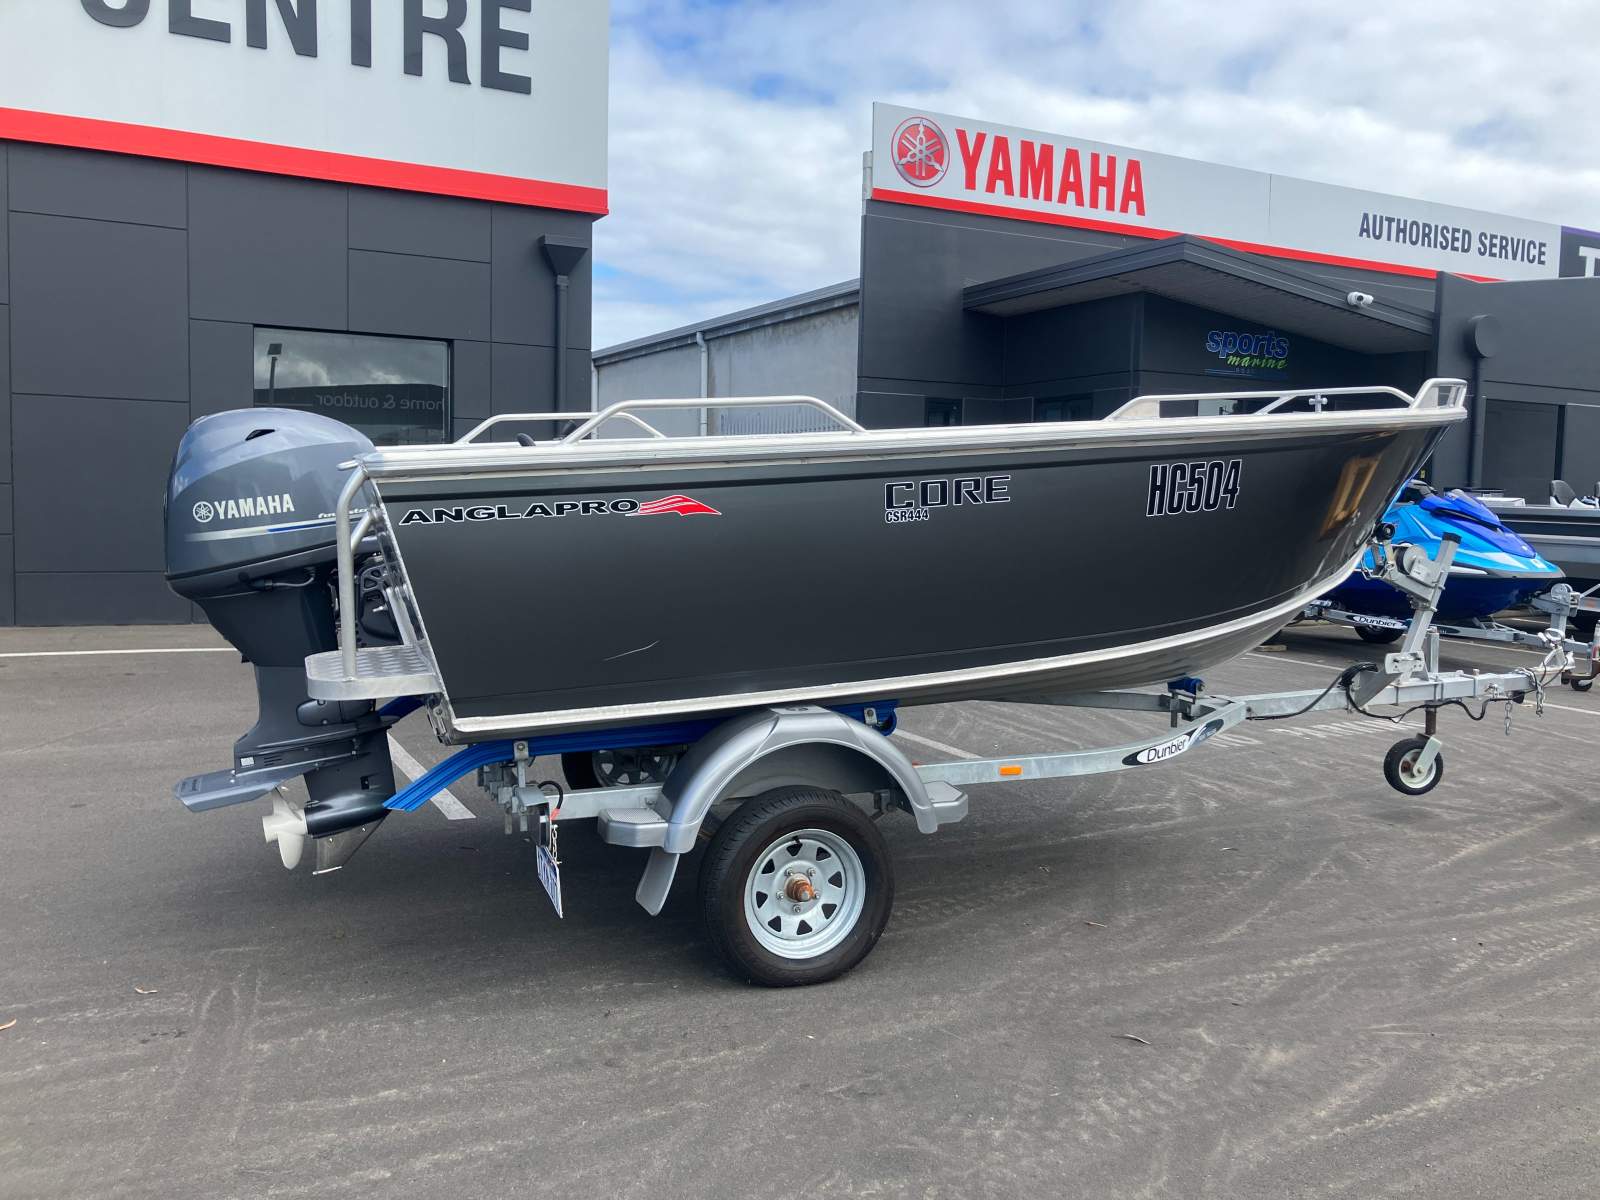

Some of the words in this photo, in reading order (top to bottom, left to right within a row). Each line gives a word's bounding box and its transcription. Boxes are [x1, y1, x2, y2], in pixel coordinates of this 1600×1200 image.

[955, 128, 1146, 217] YAMAHA
[1358, 212, 1472, 254] AUTHORISED
[1477, 231, 1547, 266] SERVICE
[1206, 331, 1289, 359] sports
[1227, 355, 1288, 369] marine
[885, 475, 1011, 510] CORE
[1146, 459, 1242, 517] HC504
[213, 493, 296, 520] YAMAHA
[399, 498, 642, 526] ANGLAPRO
[885, 508, 929, 523] CSR444
[1359, 615, 1397, 628] Dunbier
[1146, 738, 1187, 762] Dunbier
